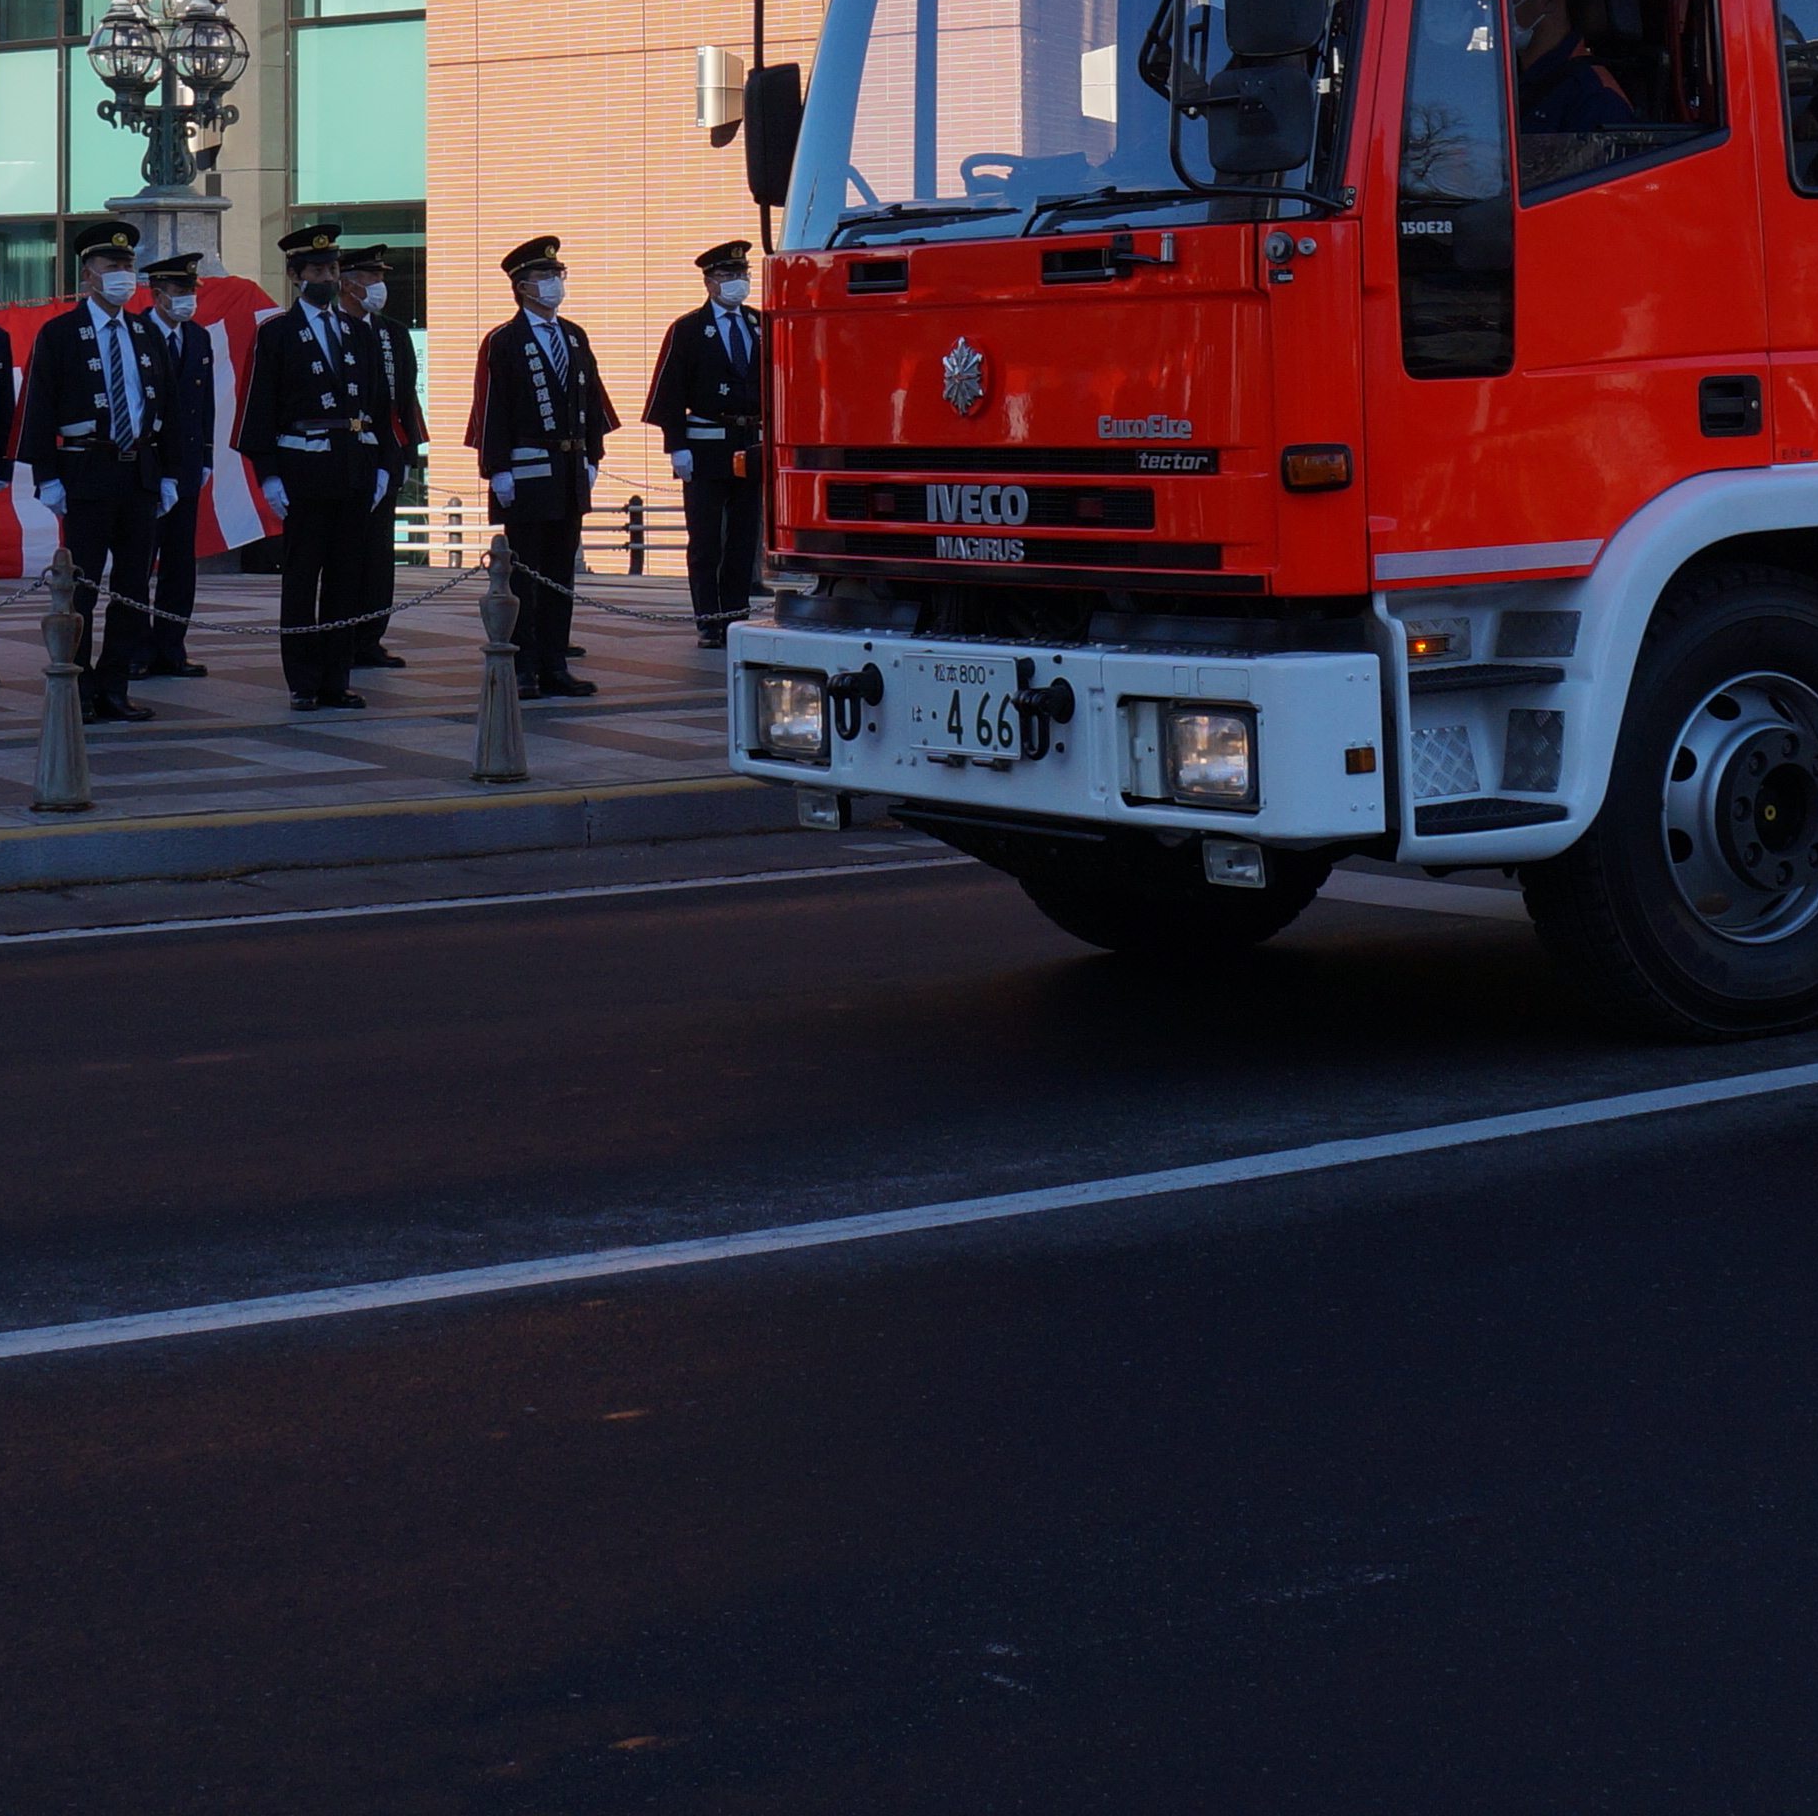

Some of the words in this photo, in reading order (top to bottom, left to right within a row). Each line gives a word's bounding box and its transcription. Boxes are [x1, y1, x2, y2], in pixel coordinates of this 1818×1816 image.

[1401, 220, 1453, 234] 150E28
[1138, 450, 1209, 471] tector
[925, 484, 1030, 525] IVECO
[935, 535, 1026, 563] MAGIRUS
